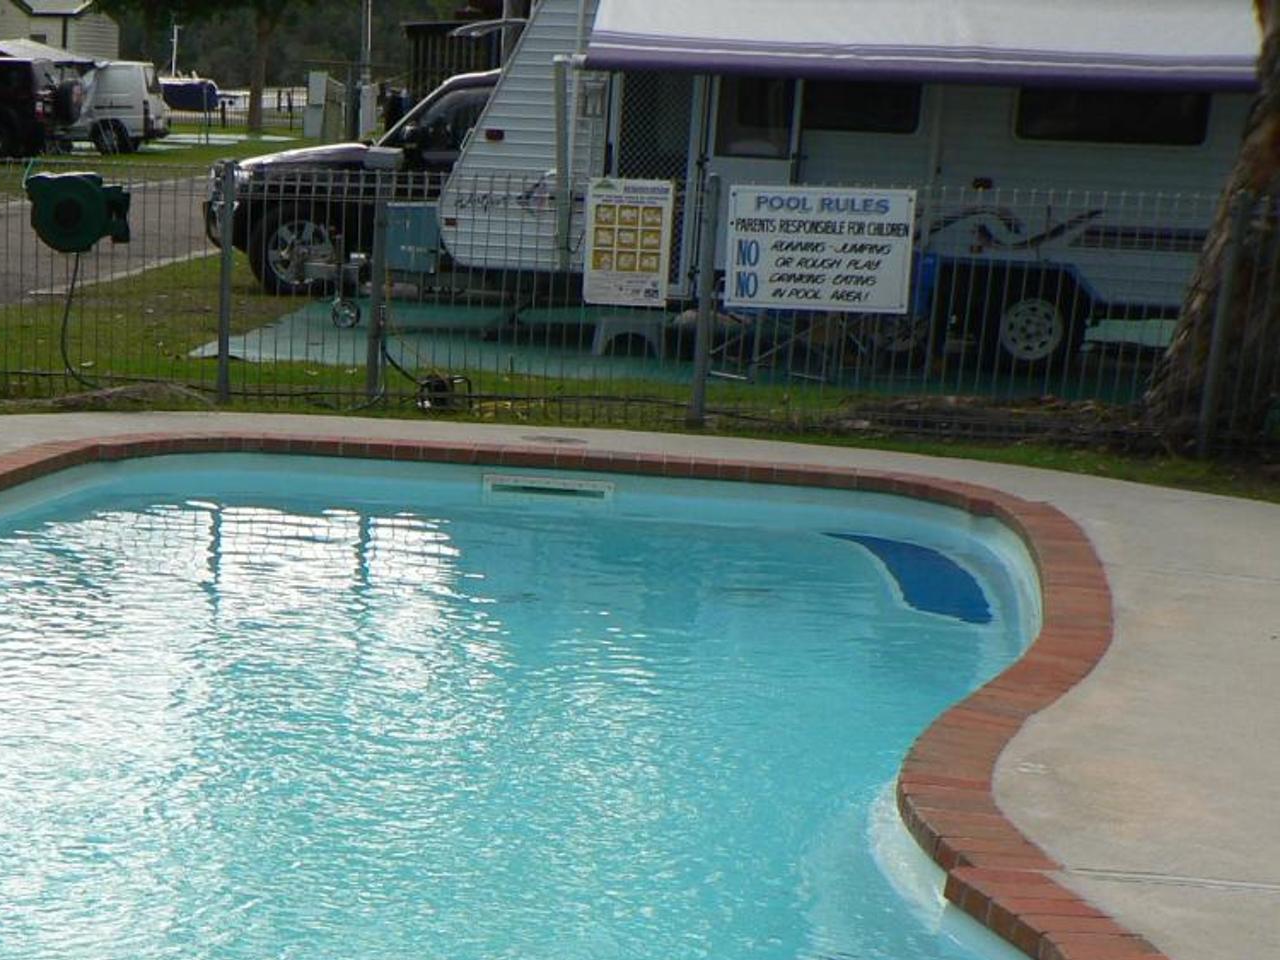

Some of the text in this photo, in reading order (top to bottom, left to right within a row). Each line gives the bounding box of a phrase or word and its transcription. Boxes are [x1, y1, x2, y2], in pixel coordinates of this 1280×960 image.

[755, 196, 890, 214] POOL RULES
[735, 218, 910, 237] PARENTS RESPONSIBLE FOR CHILDREN
[736, 239, 760, 267] NO
[775, 257, 793, 268] OR
[796, 257, 842, 269] ROUGH
[735, 271, 758, 298] NO
[772, 287, 786, 298] IN
[787, 287, 821, 300] POOL
